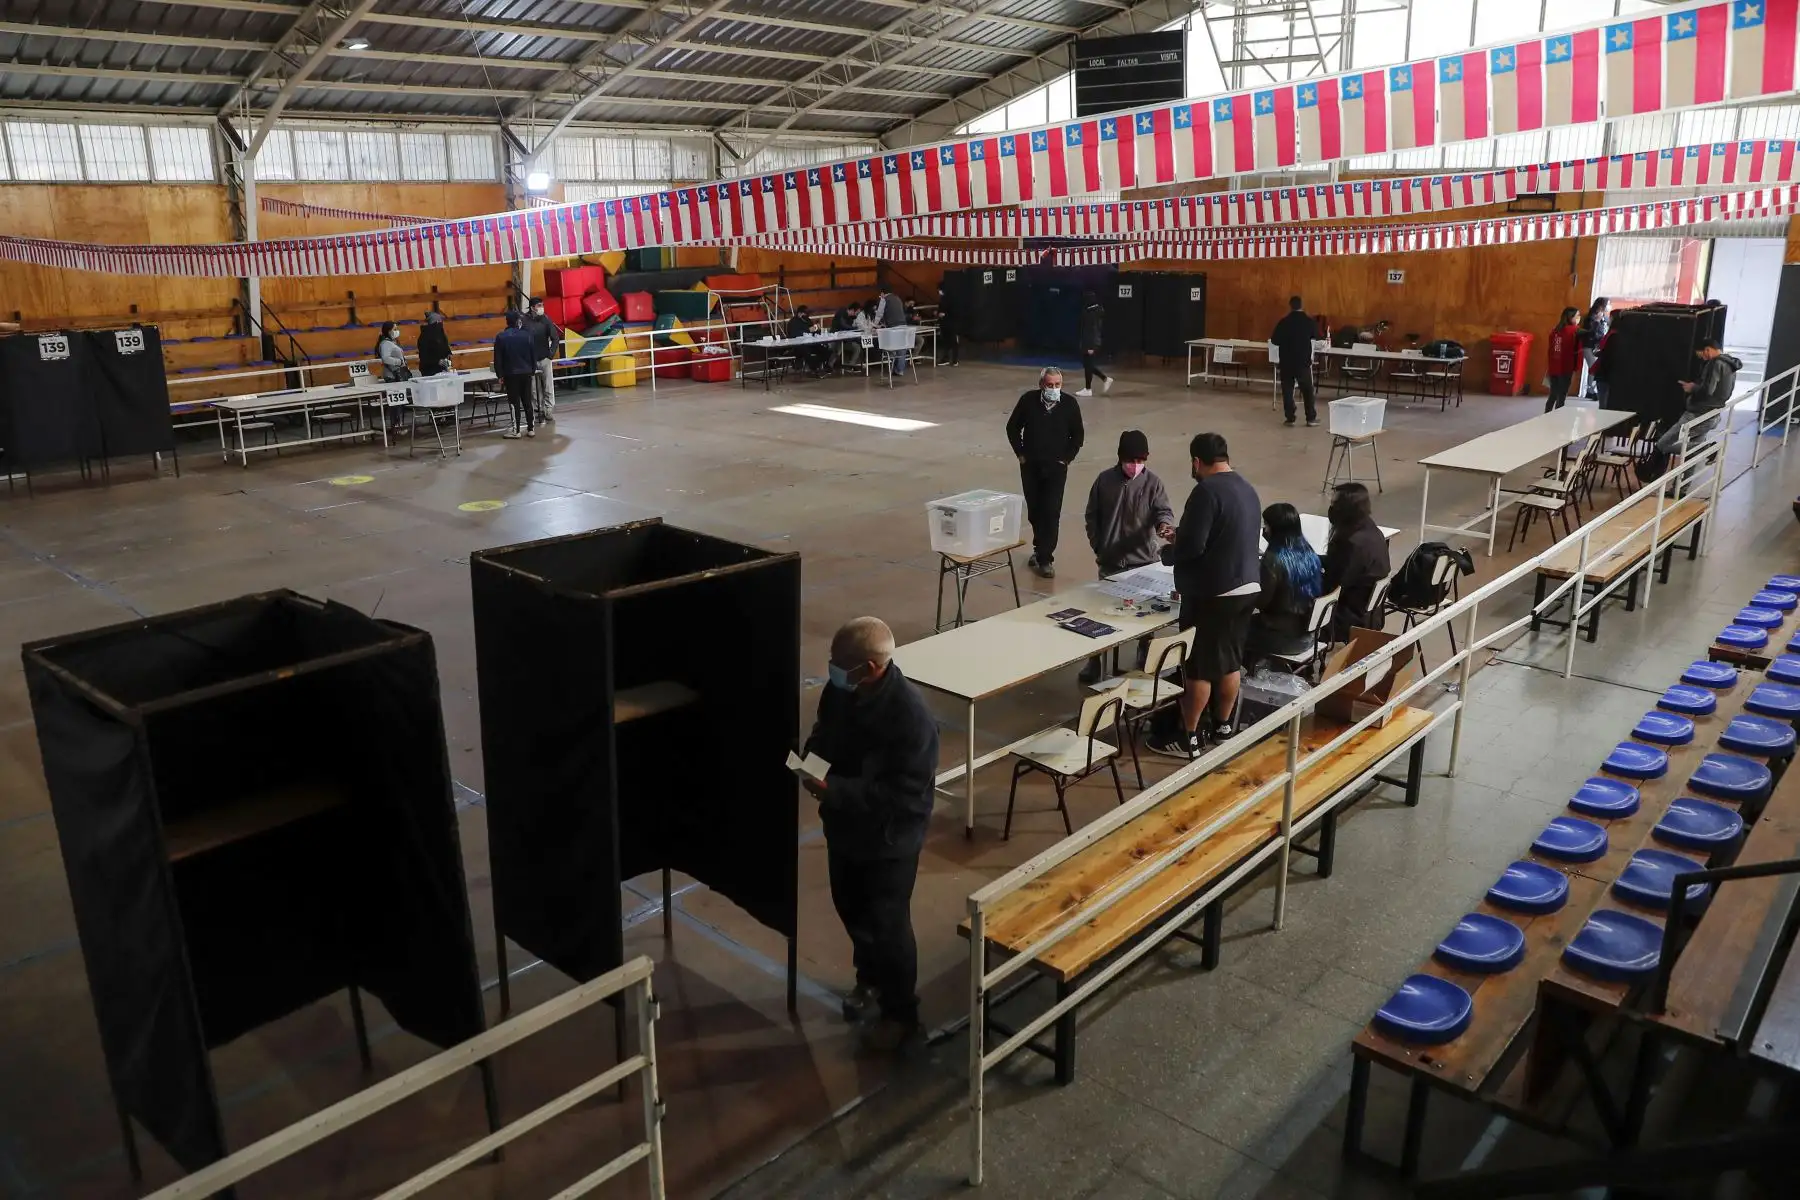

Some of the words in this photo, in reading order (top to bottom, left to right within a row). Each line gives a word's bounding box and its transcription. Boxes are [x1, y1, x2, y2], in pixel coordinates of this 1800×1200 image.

[1089, 58, 1106, 67] LOCAL
[1160, 52, 1178, 61] VISITA
[1389, 273, 1402, 281] 137
[41, 341, 66, 354] 139
[118, 335, 141, 348] 139
[350, 364, 367, 375] 139
[388, 392, 405, 403] 139
